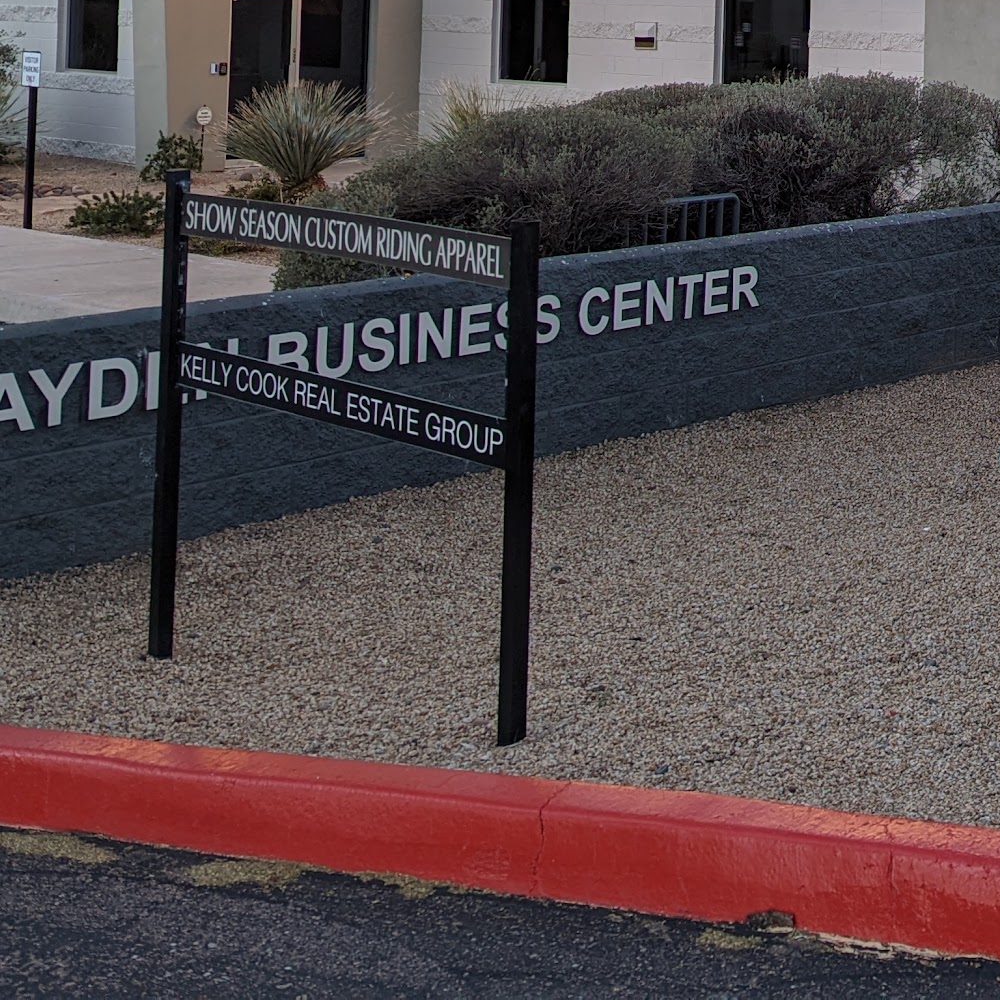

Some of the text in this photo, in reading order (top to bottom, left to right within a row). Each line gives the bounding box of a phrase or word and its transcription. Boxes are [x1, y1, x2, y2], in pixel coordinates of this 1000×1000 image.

[185, 200, 504, 279] SHOW SEASON CUSTOM RIDING APPAREL
[0, 338, 239, 431] AYD
[578, 265, 760, 335] CENTER
[180, 353, 504, 455] KELLY COOK REAL ESTATE GROUP
